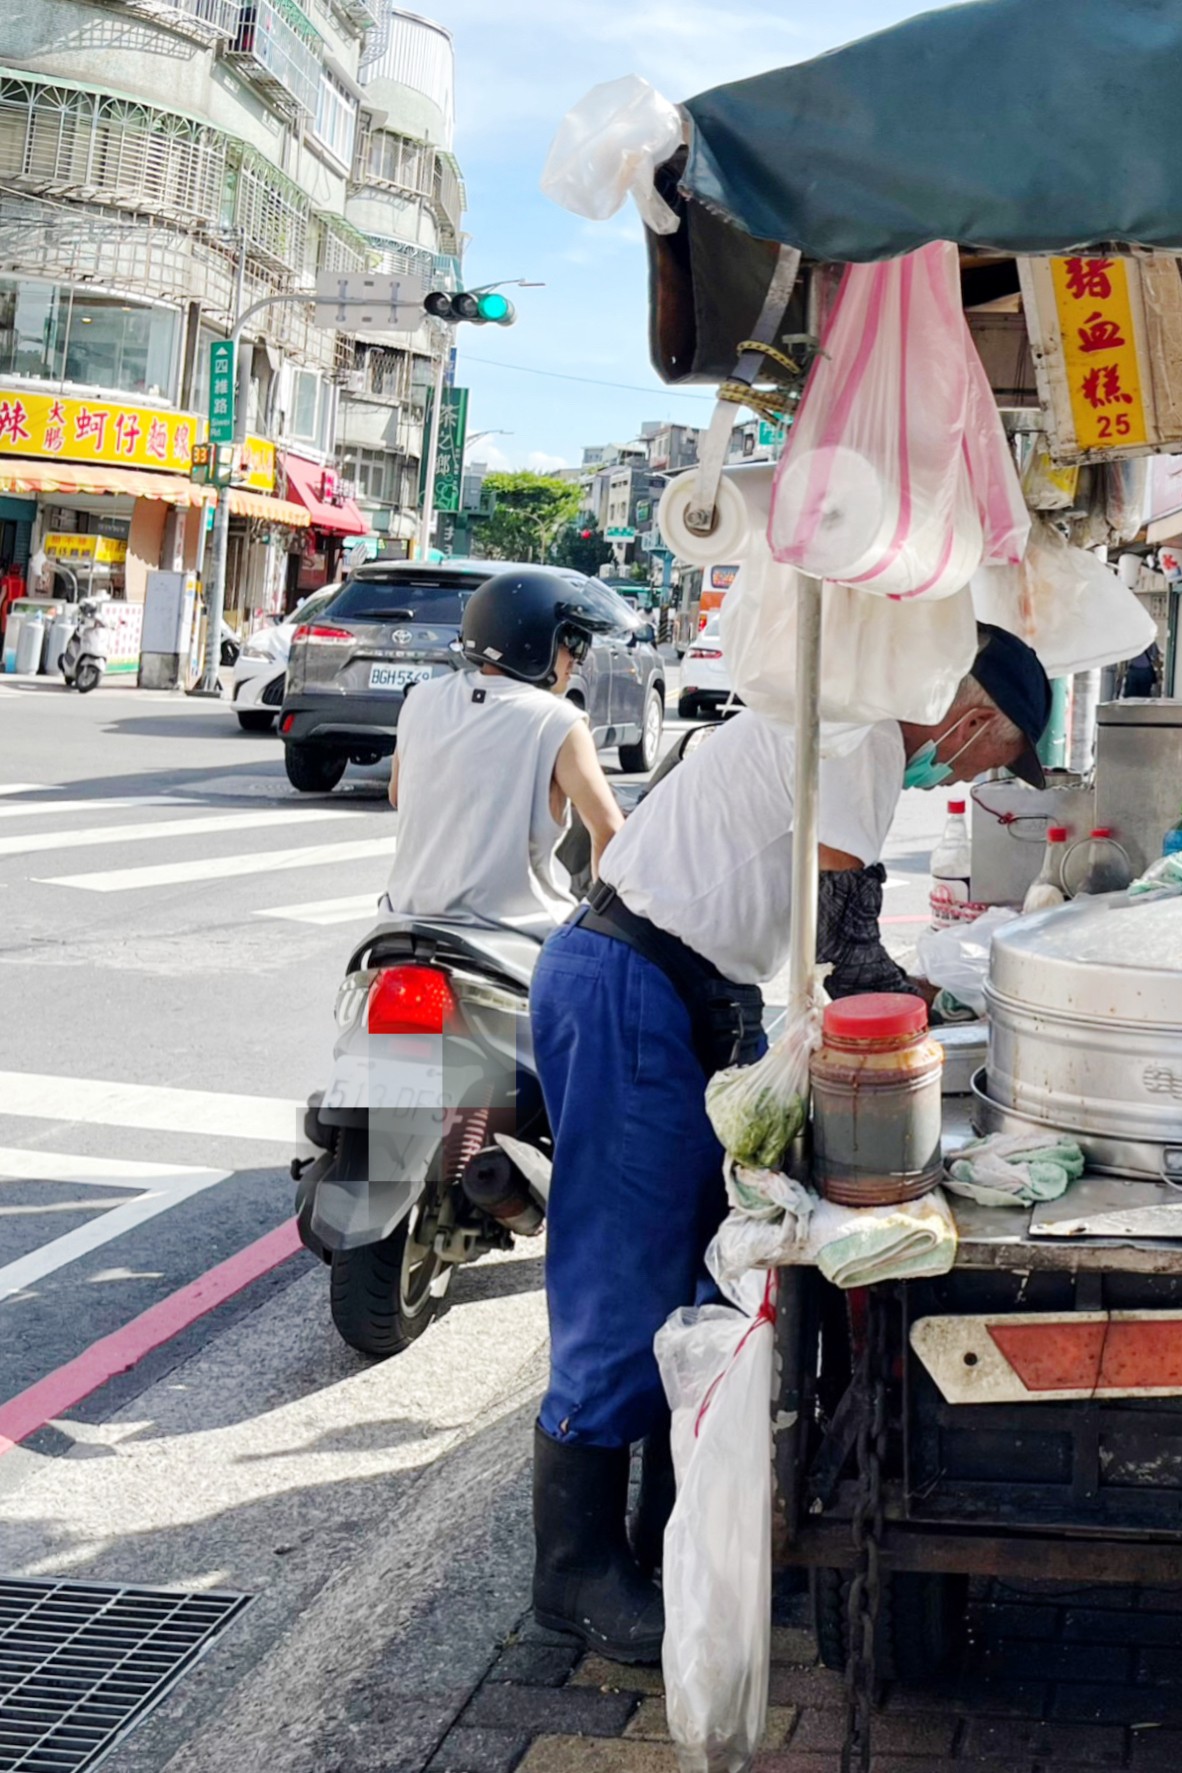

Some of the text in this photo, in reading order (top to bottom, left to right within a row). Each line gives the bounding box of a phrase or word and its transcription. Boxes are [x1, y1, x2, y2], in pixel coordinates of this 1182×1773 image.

[1064, 257, 1133, 409] 豬血糕
[214, 359, 229, 414] 四維路
[1097, 413, 1131, 438] 25
